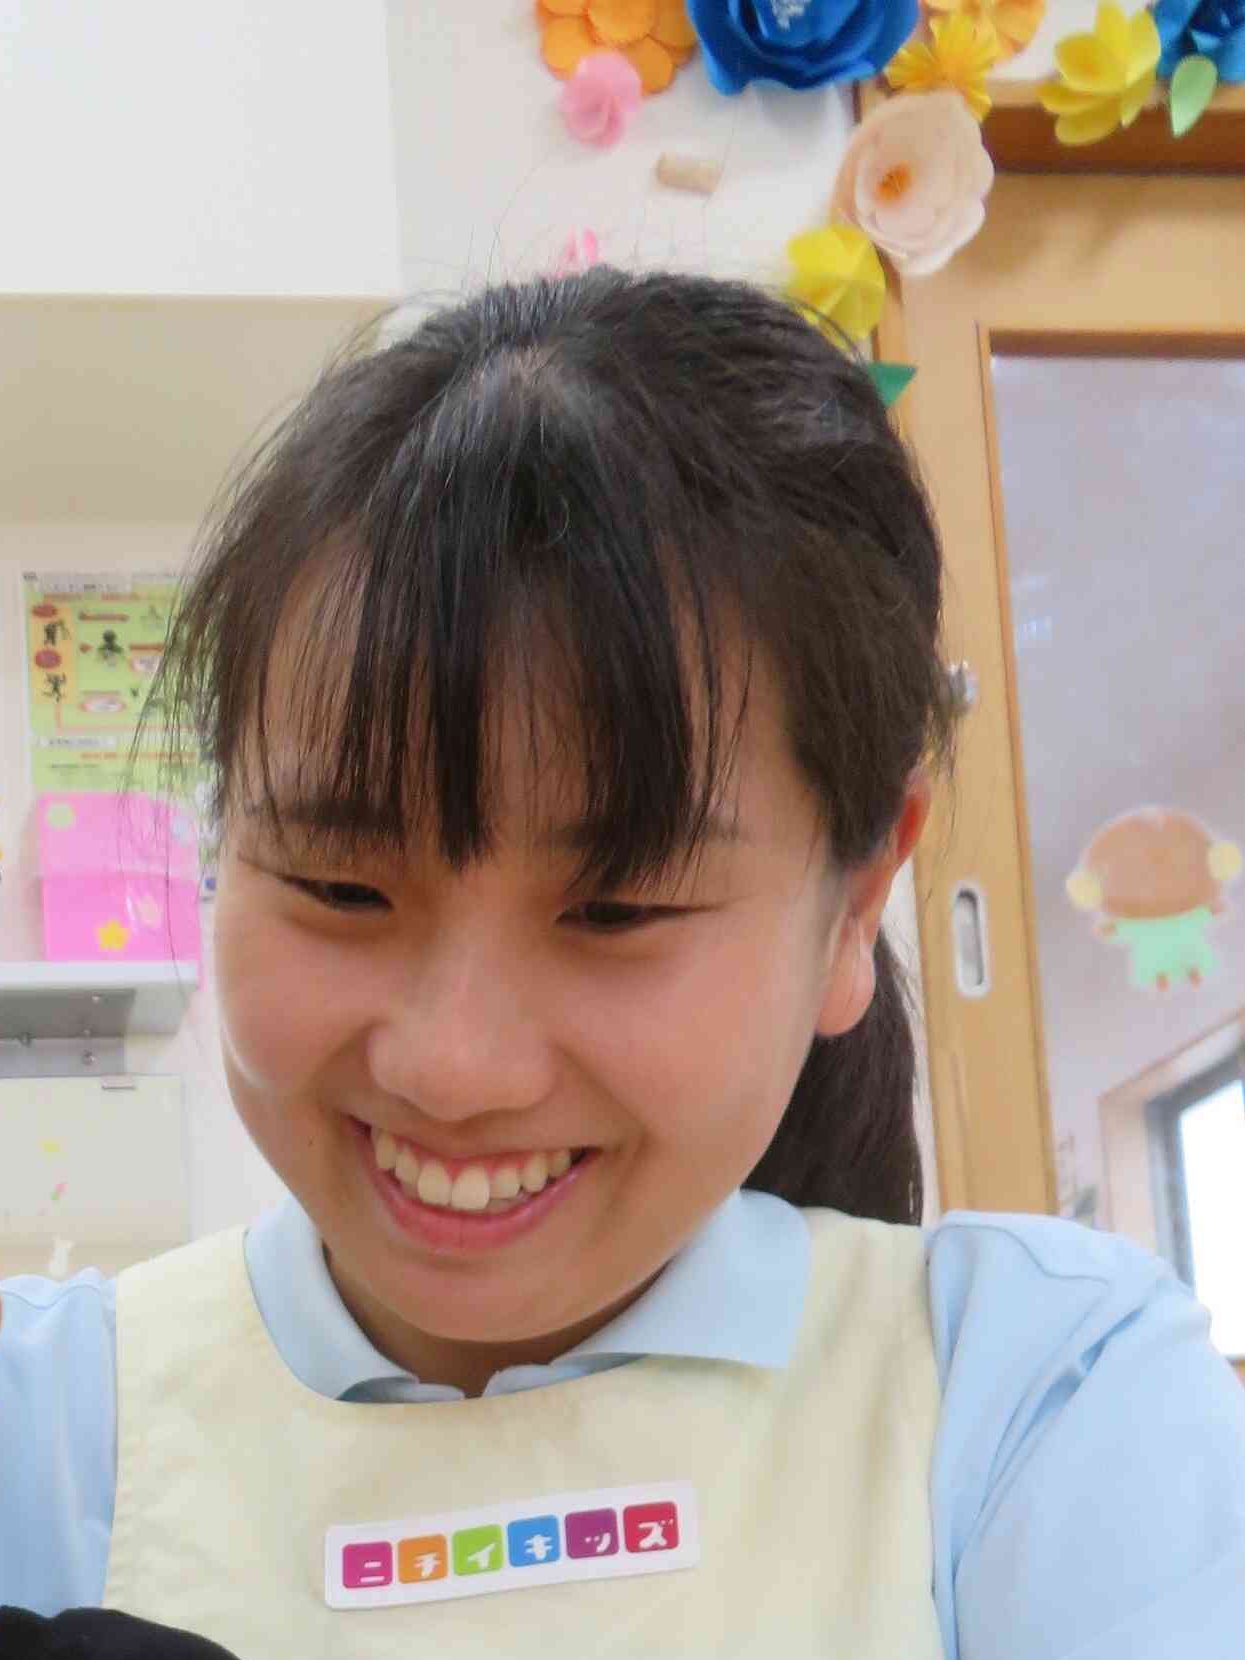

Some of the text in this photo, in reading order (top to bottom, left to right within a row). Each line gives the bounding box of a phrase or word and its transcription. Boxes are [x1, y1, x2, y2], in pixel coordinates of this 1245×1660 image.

[357, 1515, 675, 1584] ニチイキッズ
